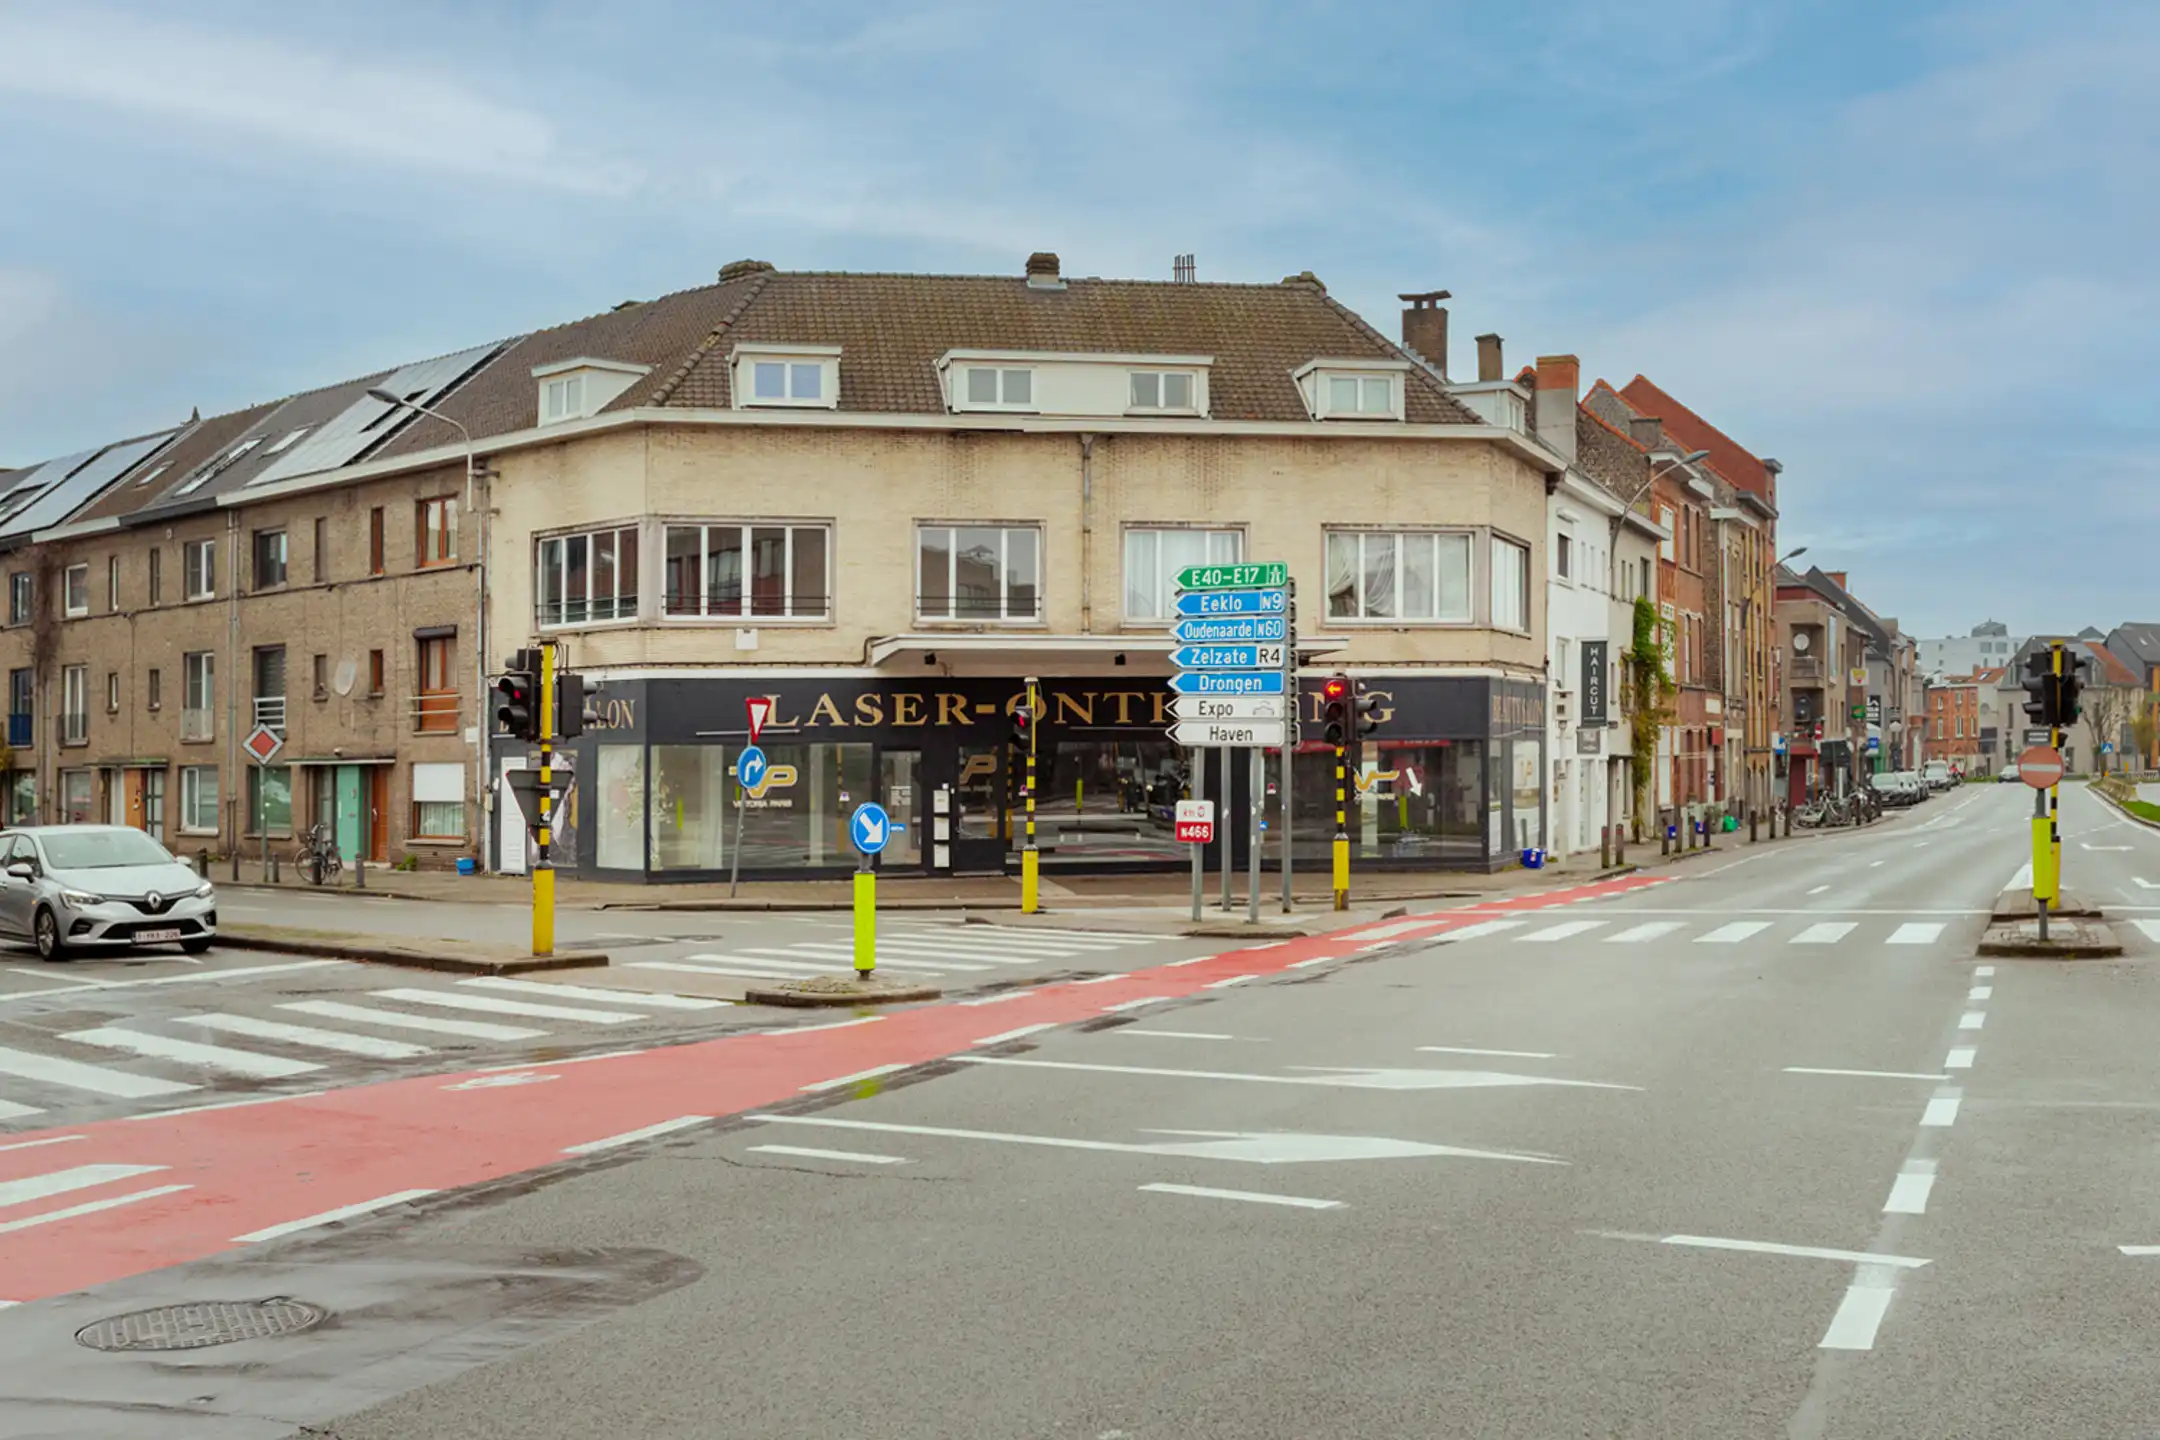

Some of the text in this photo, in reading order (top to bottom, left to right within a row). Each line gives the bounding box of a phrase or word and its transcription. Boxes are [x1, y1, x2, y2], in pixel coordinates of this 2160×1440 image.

[1191, 567, 1260, 586] E40-E17
[1201, 592, 1281, 612] Eeklo N9
[1185, 620, 1281, 639] Oudenaarde N60
[1191, 648, 1280, 664] Zelzate R4
[1199, 675, 1262, 694] Drongen
[1589, 647, 1600, 715] HAIRCUT
[1198, 700, 1234, 719] Expo
[1209, 725, 1254, 741] Haven
[1181, 825, 1209, 838] N466
